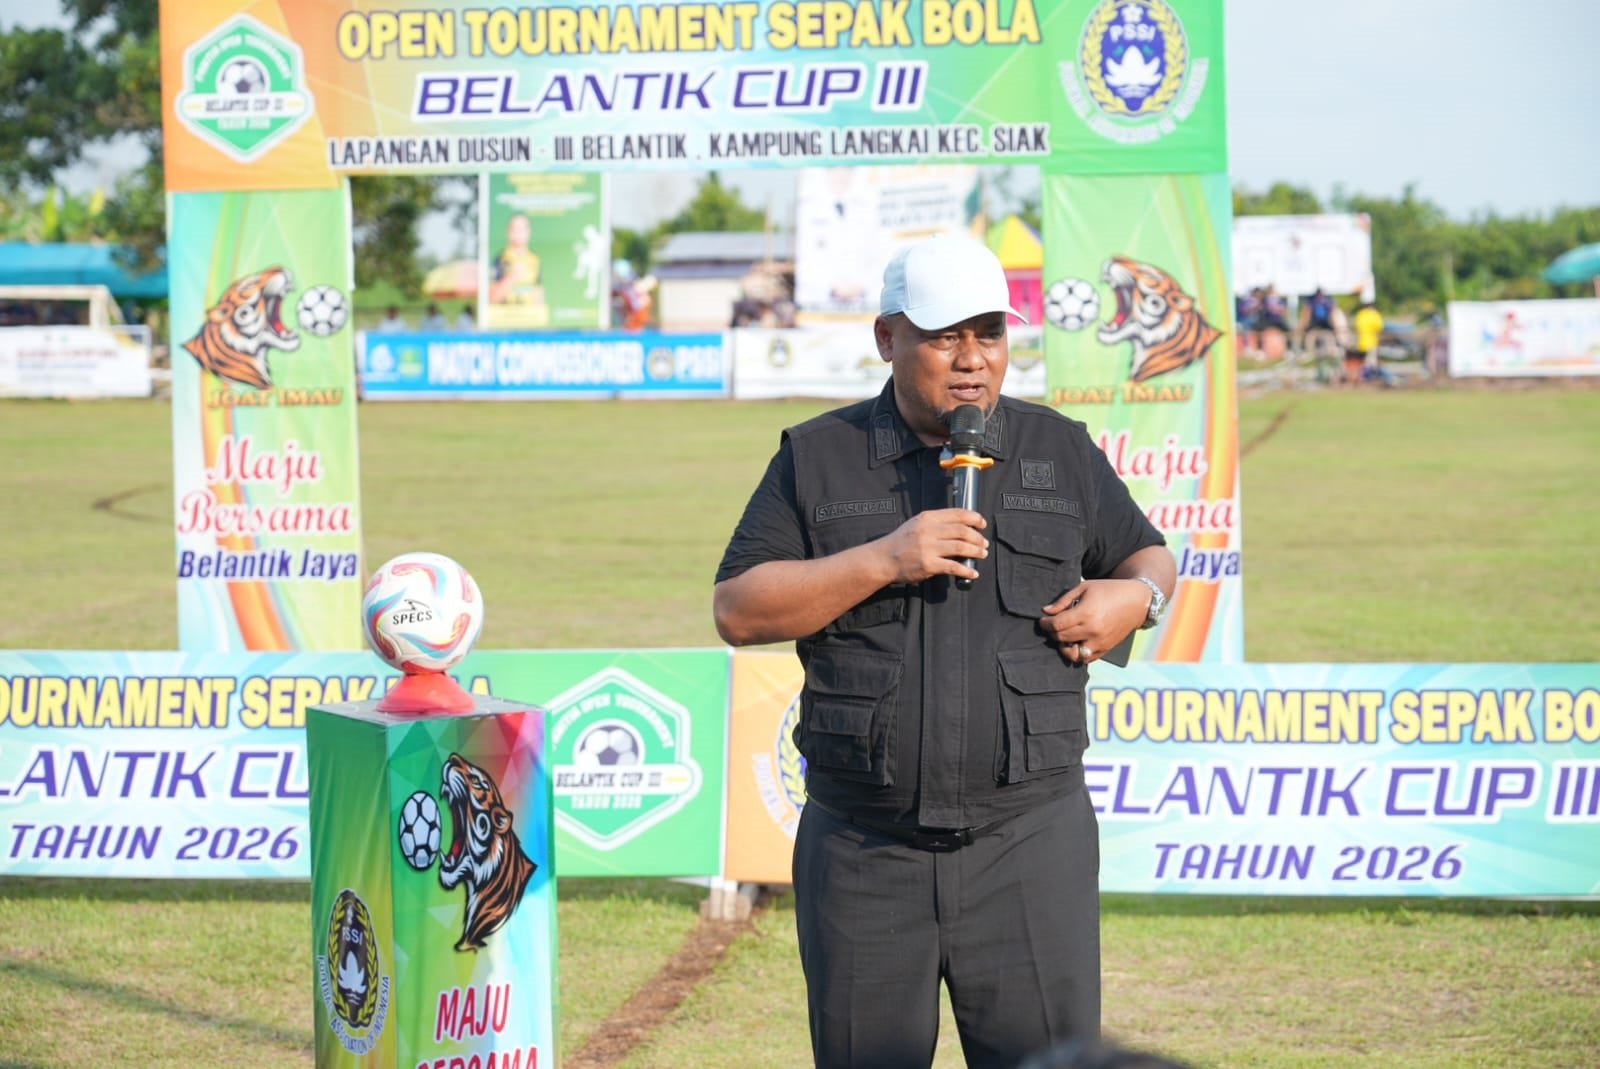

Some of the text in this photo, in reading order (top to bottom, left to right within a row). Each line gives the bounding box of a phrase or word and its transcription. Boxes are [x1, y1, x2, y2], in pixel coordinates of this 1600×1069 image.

[337, 10, 455, 60] OPEN
[464, 3, 757, 57] TOURNAMENT
[766, 1, 911, 50] SEPAK
[922, 0, 1042, 46] BOLA
[1109, 24, 1156, 42] PSSI
[418, 67, 922, 115] BELANTIK CUP III
[330, 136, 448, 166] LAPANGAN
[458, 136, 531, 162] DUSUN
[554, 135, 573, 161] III
[582, 132, 687, 161] BELANTIK
[709, 130, 822, 158] KAMPUNG
[831, 127, 930, 156] LANGKAI
[938, 126, 986, 153] KEC.
[994, 124, 1047, 152] SIAK
[207, 438, 322, 494] Maju
[178, 490, 352, 534] Bersama
[178, 549, 358, 580] Belantik Jaya
[1178, 548, 1241, 579] Jaya
[392, 611, 433, 626] SPECS
[1089, 687, 1600, 744] TOURNAMENT SEPAK BO
[230, 751, 309, 798] CU
[1084, 764, 1600, 816] ELANTIK CUP III
[9, 824, 299, 862] TAHUN 2026
[1153, 842, 1463, 882] TAHUN 2026
[435, 983, 510, 1041] MAJU
